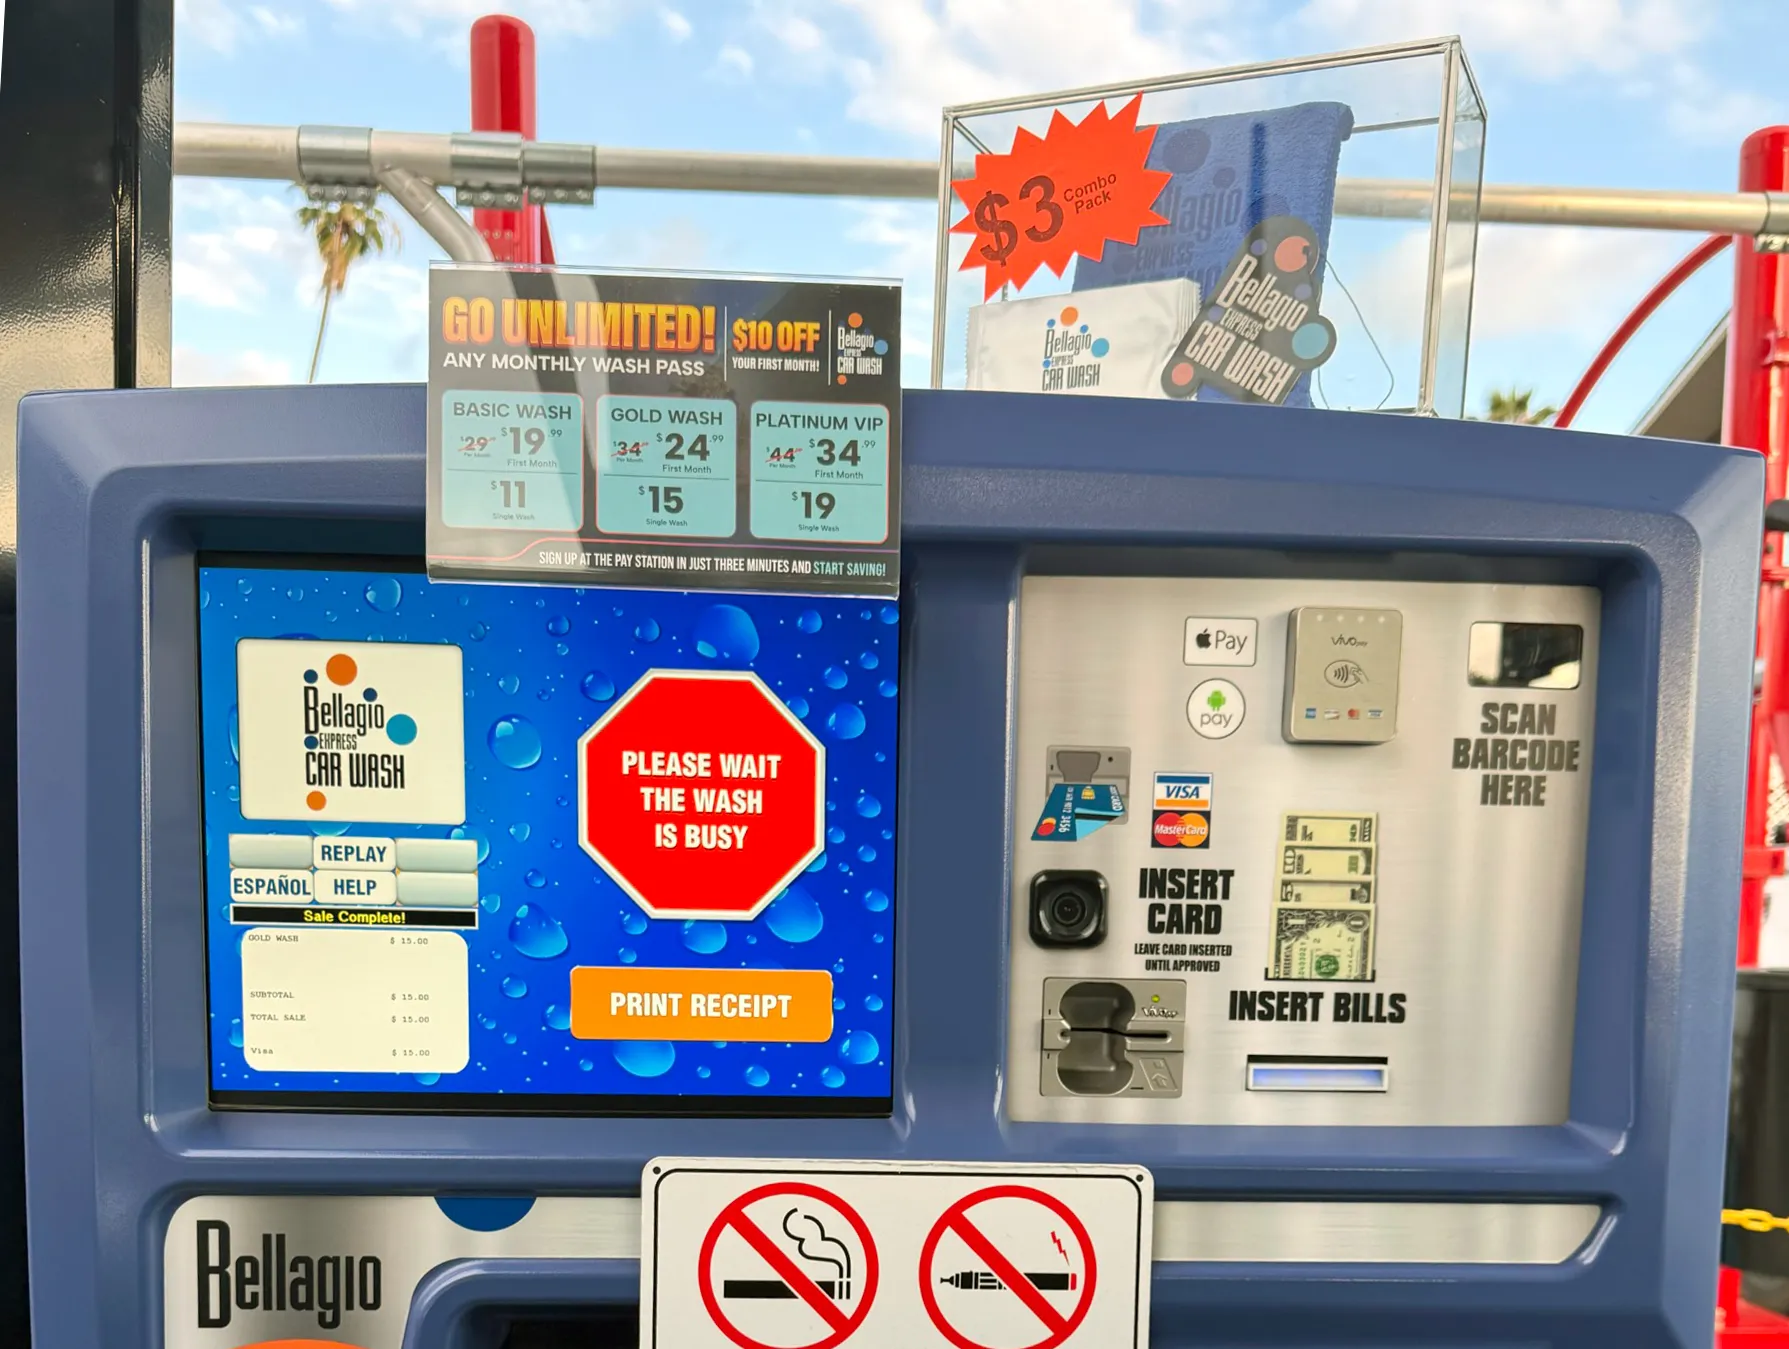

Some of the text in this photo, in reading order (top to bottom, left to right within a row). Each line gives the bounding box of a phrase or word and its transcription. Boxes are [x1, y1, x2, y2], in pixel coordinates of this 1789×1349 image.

[1063, 173, 1117, 202] Combo
[1074, 189, 1112, 214] Pack
[974, 175, 1063, 266] $3
[1216, 254, 1309, 332] Bellagio
[442, 297, 716, 353] GO UNLIMITED!
[732, 318, 820, 352] $10 OFF
[1220, 308, 1263, 341] EXPRESS
[837, 326, 875, 351] Bellagio
[1044, 328, 1092, 359] Bellagio
[443, 352, 705, 377] ANY MONTHLY WASH PASS
[732, 357, 820, 372] YOUR FIRST MONTH!
[837, 357, 882, 375] CAR WASH
[1184, 320, 1296, 403] CAR WASH
[1042, 363, 1101, 391] CAR WASH
[453, 402, 571, 420] BASIC WASH
[611, 408, 722, 425] GOLD WASH
[756, 413, 883, 431] PLATINUM VIP
[507, 459, 557, 468] First Month
[662, 464, 712, 474] First Month
[815, 469, 864, 480] First Month
[490, 480, 526, 508] $11
[638, 485, 684, 514] $15
[791, 491, 836, 520] $19
[493, 513, 514, 521] Single
[646, 518, 688, 527] Single Wash
[798, 524, 819, 532] Single
[539, 551, 886, 577] SIGN UP AT THE PAY STATION IN JUST THREE MINUTES AND START SAVING!
[1215, 630, 1247, 655] Pay
[303, 685, 385, 736] Bellagio
[1200, 712, 1232, 728] pay
[1480, 702, 1557, 735] SCAN
[319, 733, 357, 750] EXPRESS
[621, 750, 782, 779] PLEASE WAIT
[1452, 738, 1580, 772] BARCODE
[306, 752, 405, 789] CAR WASH
[640, 786, 763, 814] THE WASH
[1165, 785, 1201, 799] VISA
[1480, 774, 1547, 806] HERE
[655, 823, 748, 850] IS BUSY
[1155, 825, 1207, 835] MasterCard
[320, 845, 387, 863] REPLAY
[234, 873, 311, 895] ESPAÑOL
[333, 879, 377, 895] HELP
[1139, 868, 1234, 900] INSERT
[303, 910, 406, 924] Sale Complete!
[1147, 903, 1222, 935] CARD
[248, 934, 299, 943] GOLD WASH
[390, 937, 429, 945] $ 15.00
[1134, 943, 1232, 956] LEAVE CARD INSERTED
[1145, 959, 1220, 972] UNTIL APPROVED
[250, 991, 295, 999] SUBTOTAL
[391, 993, 396, 1001] $
[610, 992, 792, 1018] PRINT RECEIPT
[1228, 990, 1407, 1023] INSERT BILLS
[391, 1016, 430, 1024] $ 15.00
[251, 1047, 274, 1055] Visa
[392, 1049, 397, 1057] $
[196, 1219, 382, 1329] Bellagio
